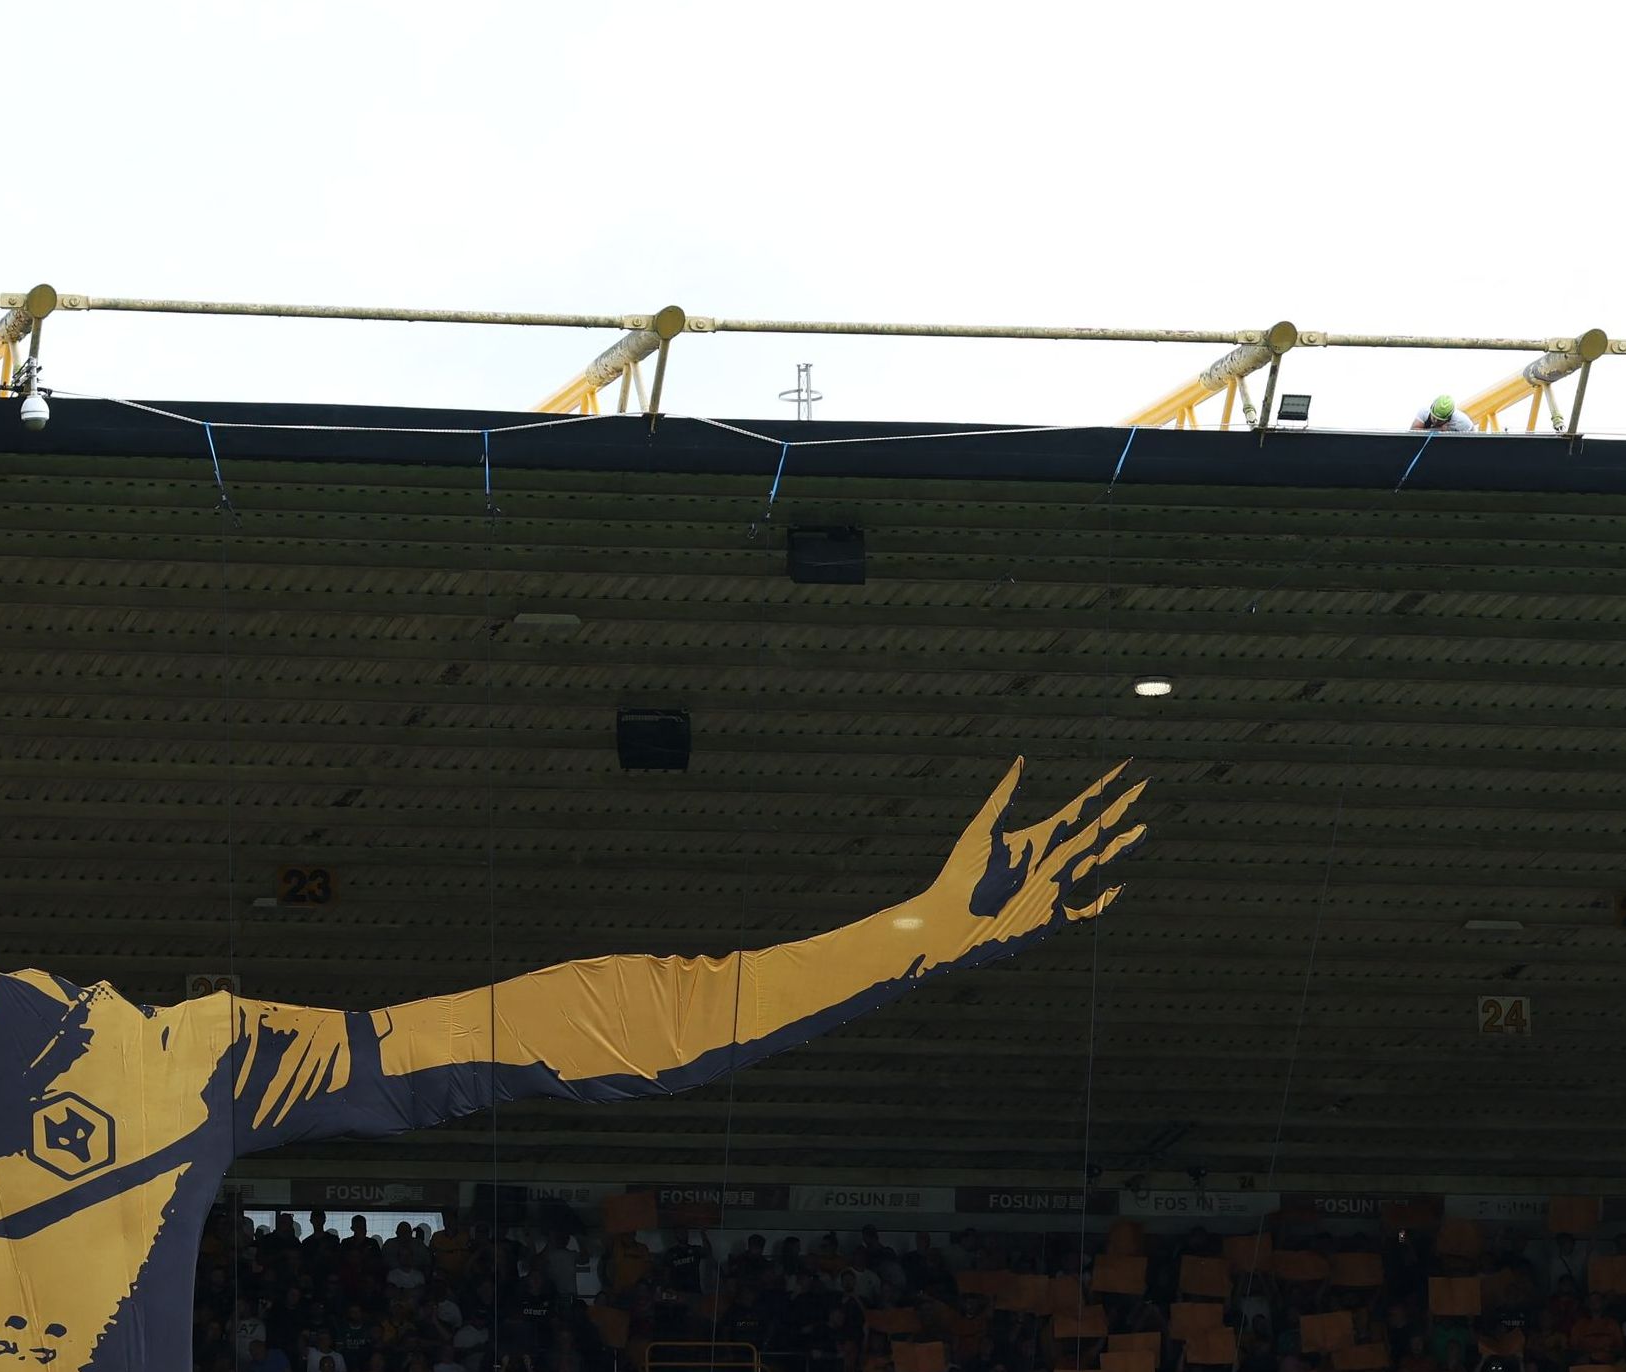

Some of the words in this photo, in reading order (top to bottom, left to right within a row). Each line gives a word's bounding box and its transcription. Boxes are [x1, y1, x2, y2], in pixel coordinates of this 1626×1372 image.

[282, 868, 331, 904] 23
[1482, 999, 1526, 1033] 24
[326, 1184, 385, 1199] FOSUN
[661, 1190, 720, 1203] FOSUN
[825, 1193, 885, 1206] FOSUN
[989, 1194, 1048, 1209] FOSUN
